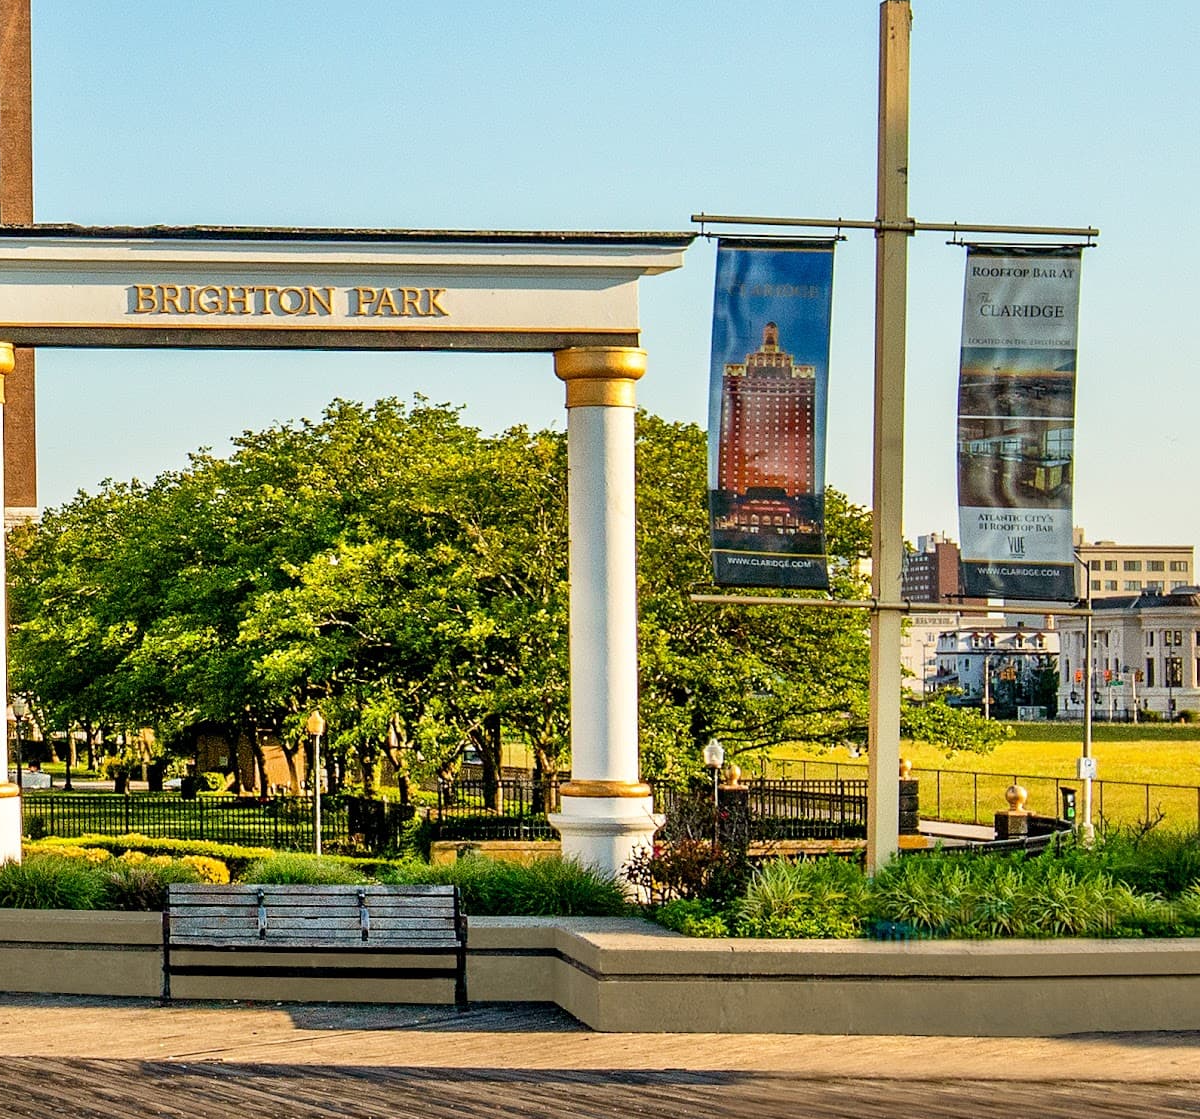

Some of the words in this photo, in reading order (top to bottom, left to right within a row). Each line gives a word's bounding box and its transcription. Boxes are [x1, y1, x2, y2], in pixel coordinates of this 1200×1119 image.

[972, 267, 1029, 278] ROOFTOP
[1033, 268, 1056, 278] BAR
[1060, 268, 1075, 279] AT
[133, 284, 336, 315] BRIGHTON
[355, 287, 449, 316] PARK
[980, 304, 1065, 318] CLARIDGE
[978, 513, 1020, 521] ATLANTIC
[1025, 513, 1054, 522] CITY'S
[990, 523, 1034, 532] ROOFTOP
[1036, 524, 1054, 532] BAR
[1007, 536, 1026, 553] VUE
[727, 557, 812, 568] WWW.CLARIDGE.COM
[977, 567, 1060, 577] WWW.CLARIDGE.COM
